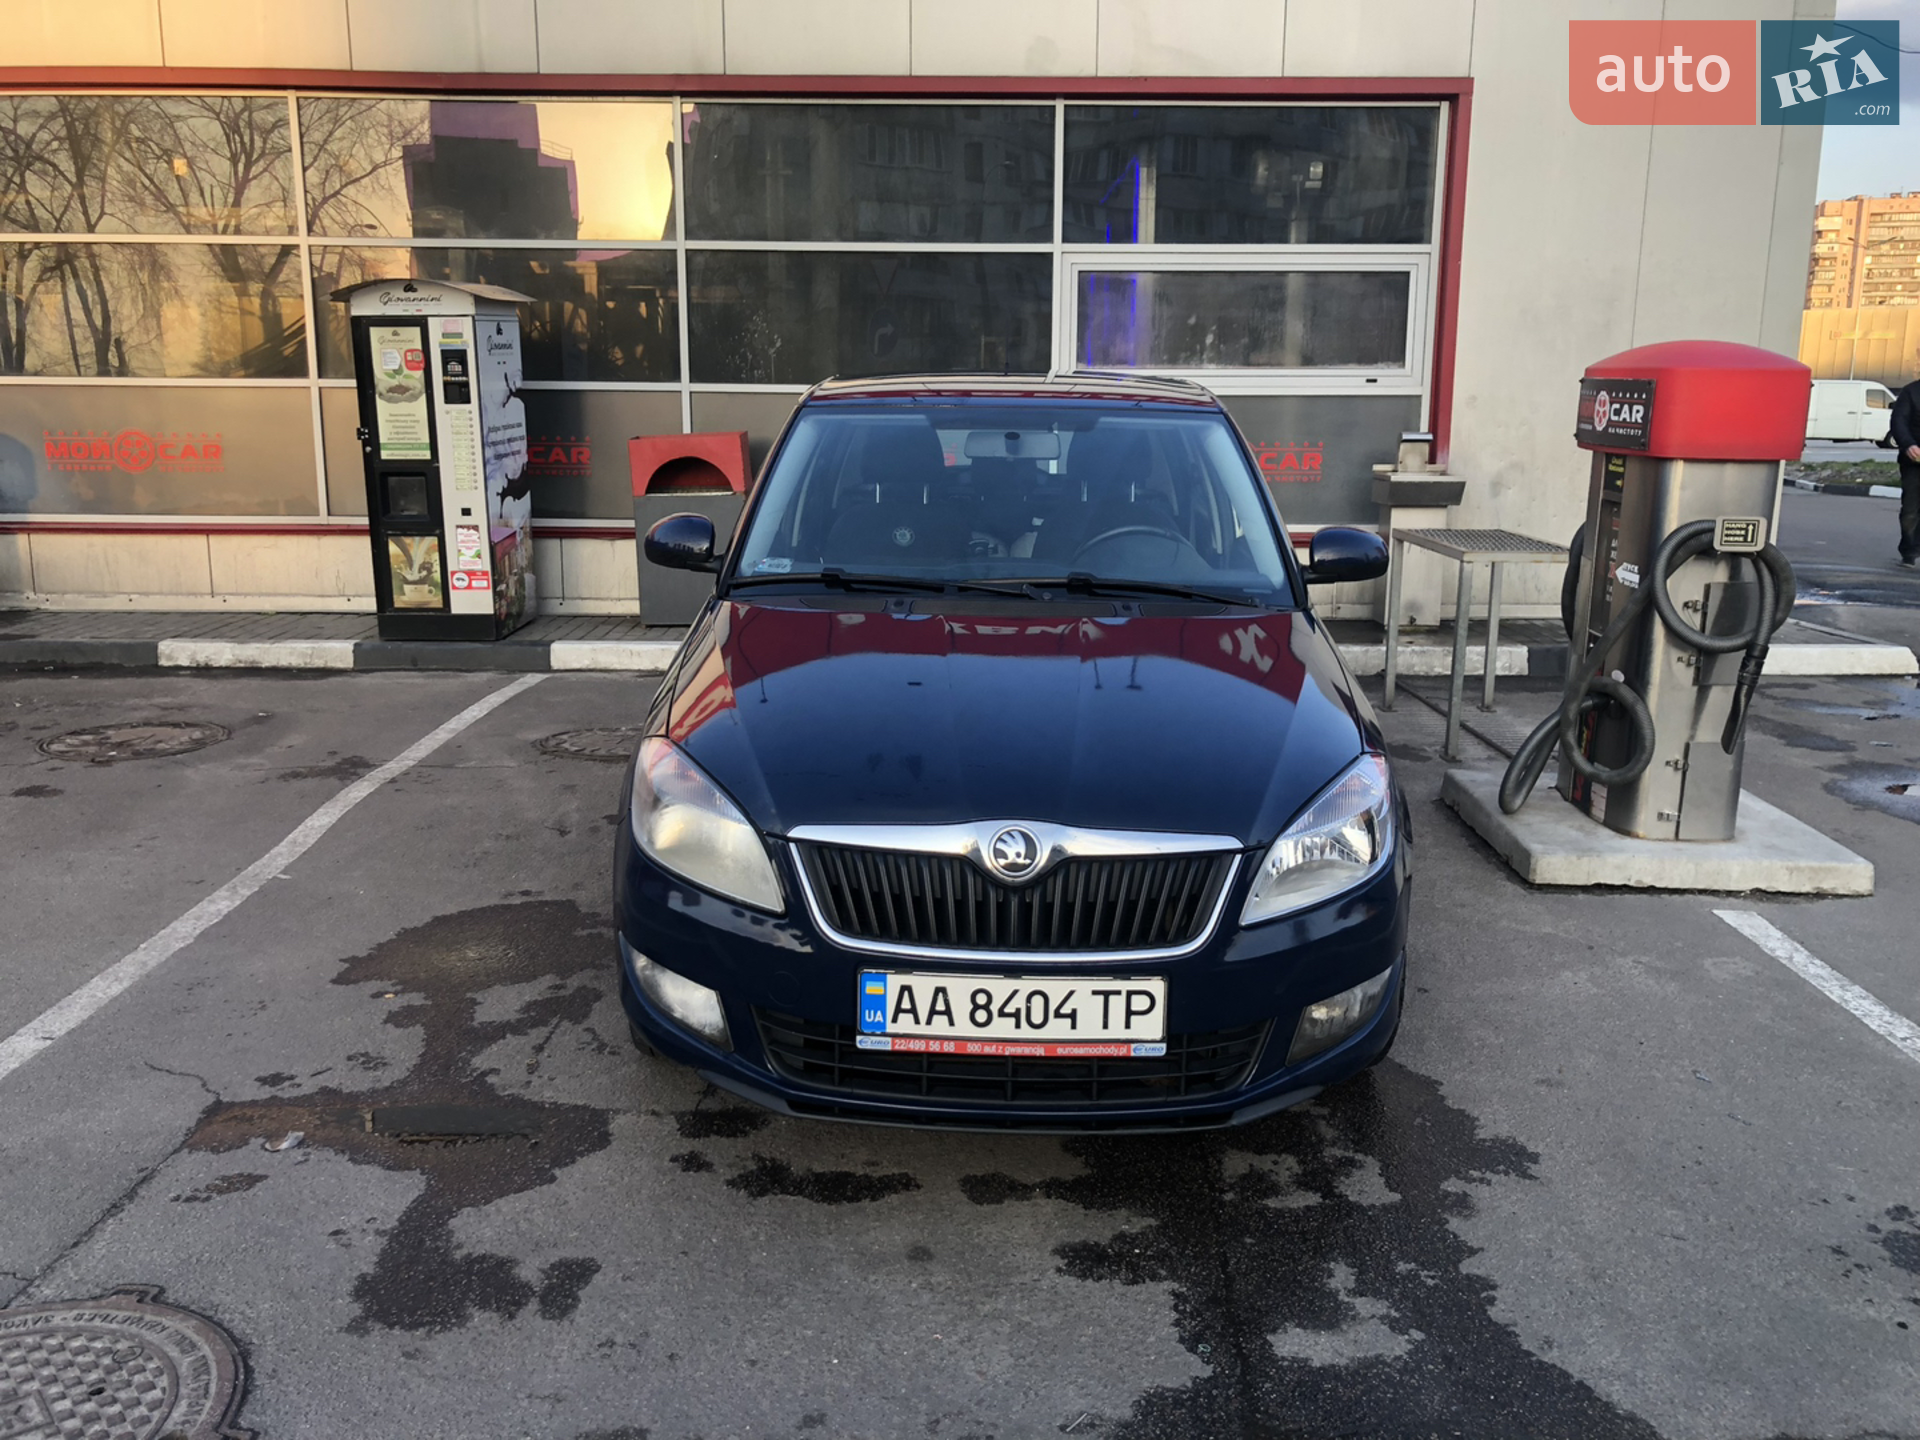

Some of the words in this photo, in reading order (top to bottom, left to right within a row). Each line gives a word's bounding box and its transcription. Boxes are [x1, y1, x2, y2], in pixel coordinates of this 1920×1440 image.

[379, 292, 443, 306] Giovannini
[1610, 403, 1645, 424] CAR
[44, 440, 111, 459] МОЙ
[159, 444, 223, 460] CAR
[528, 447, 591, 465] CAR
[1258, 452, 1323, 470] CAR
[890, 984, 956, 1028] AA
[969, 987, 1078, 1030] 8404
[1091, 989, 1157, 1030] TP
[864, 1009, 884, 1024] UA
[894, 1039, 926, 1050] 22/499
[929, 1041, 940, 1051] 56
[943, 1041, 955, 1052] 68
[967, 1043, 982, 1053] 500
[1005, 1046, 1045, 1056] gwarancją
[1057, 1045, 1128, 1056] eurosamochody.pl
